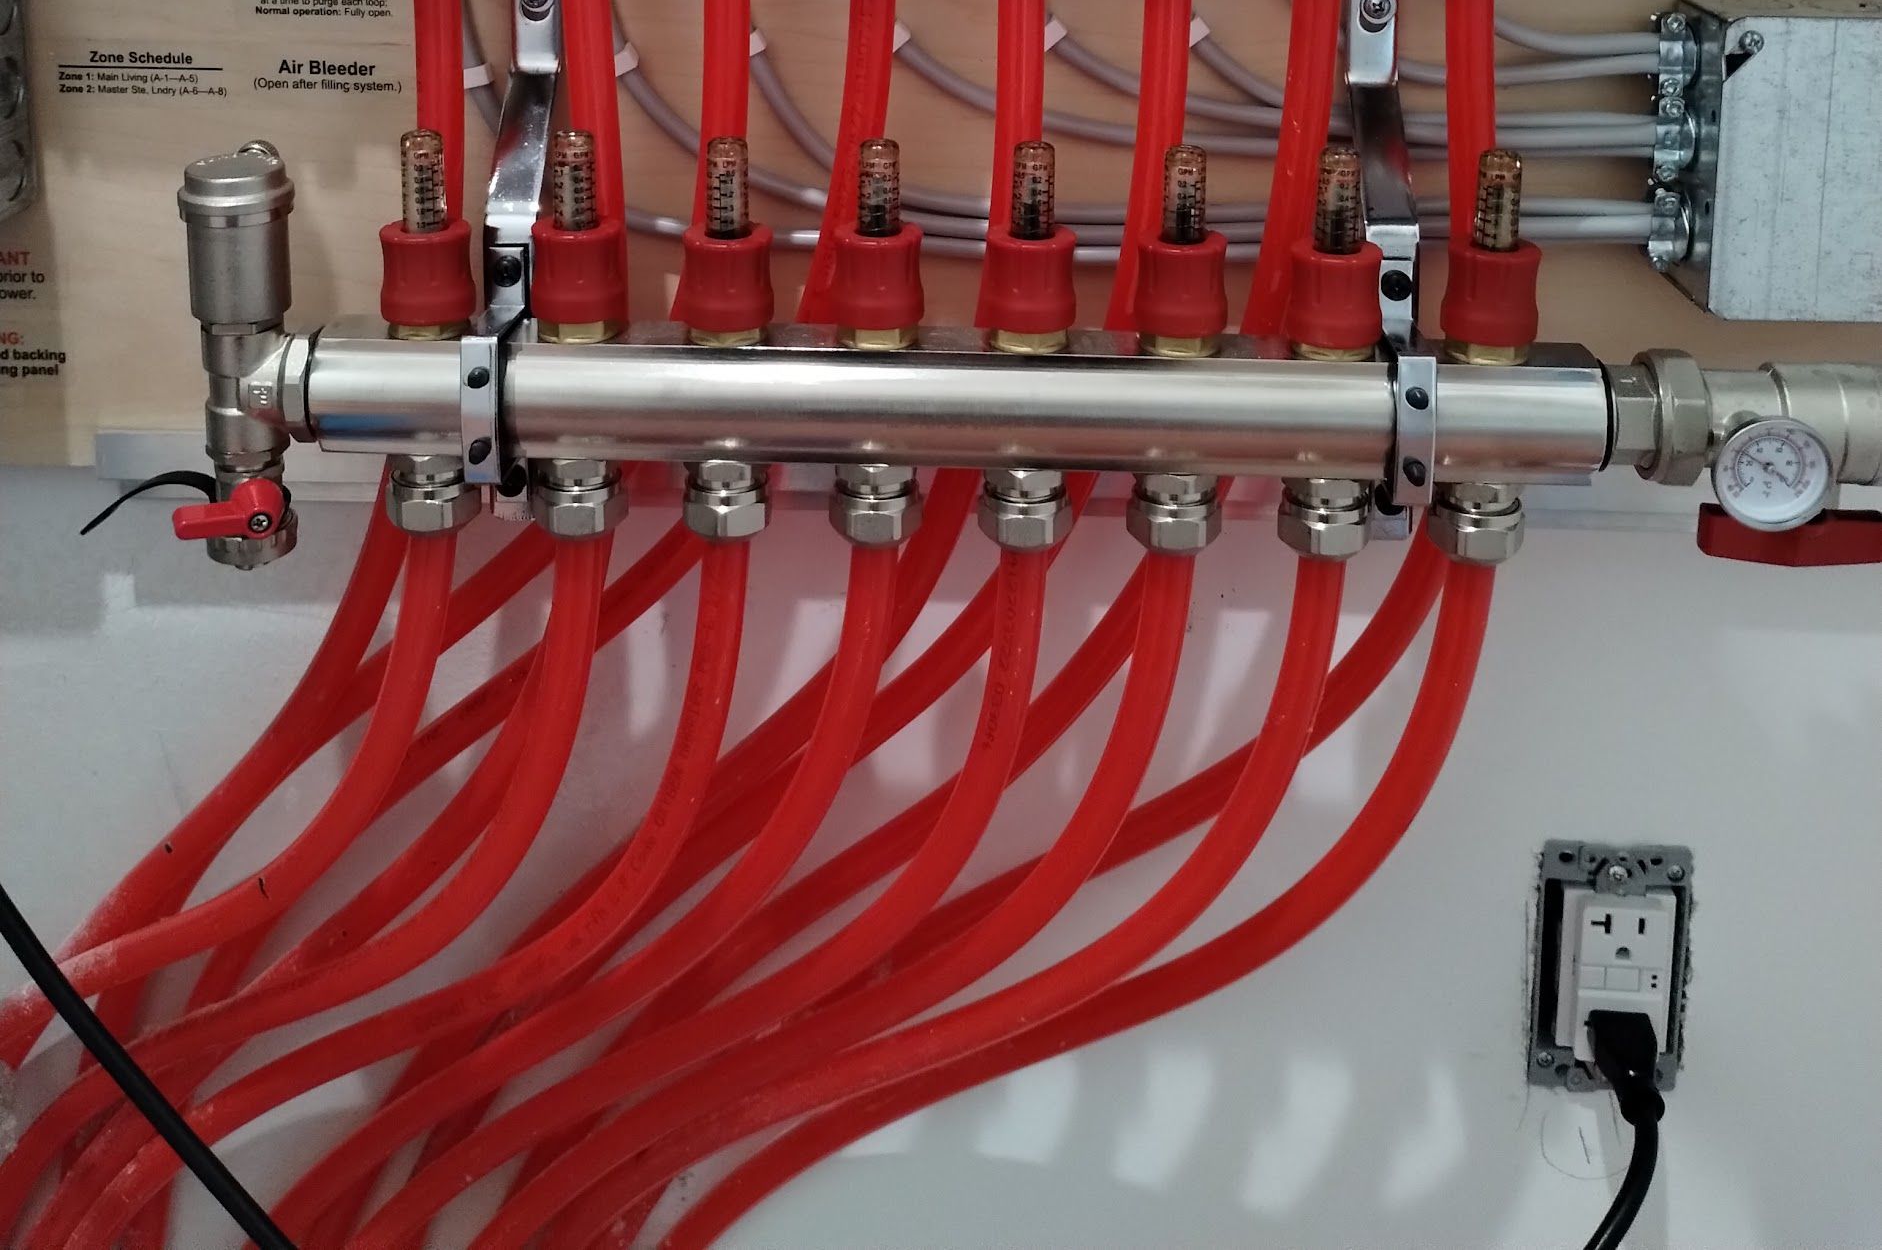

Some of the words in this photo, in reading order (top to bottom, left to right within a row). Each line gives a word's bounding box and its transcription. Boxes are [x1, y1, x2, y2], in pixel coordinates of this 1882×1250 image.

[312, 0, 339, 7] purge
[255, 6, 290, 15] Normal
[293, 8, 342, 16] operation:
[344, 8, 366, 18] Fully
[89, 51, 124, 63] Zone
[128, 51, 193, 64] Schedule
[279, 60, 304, 74] Air
[309, 60, 376, 76] Bleeder
[59, 72, 83, 81] Zone
[86, 72, 94, 81] 1:
[97, 73, 119, 81] Main
[121, 73, 148, 83] Living
[59, 84, 83, 93] Zone
[86, 85, 95, 93] 2:
[97, 85, 128, 94] Master
[151, 86, 176, 97] Lndry
[254, 78, 289, 90] (Open
[292, 79, 318, 89] after
[320, 79, 350, 92] filling
[353, 81, 402, 94] system.)
[31, 271, 45, 283] to
[13, 349, 66, 364] backing
[22, 364, 59, 377] panel
